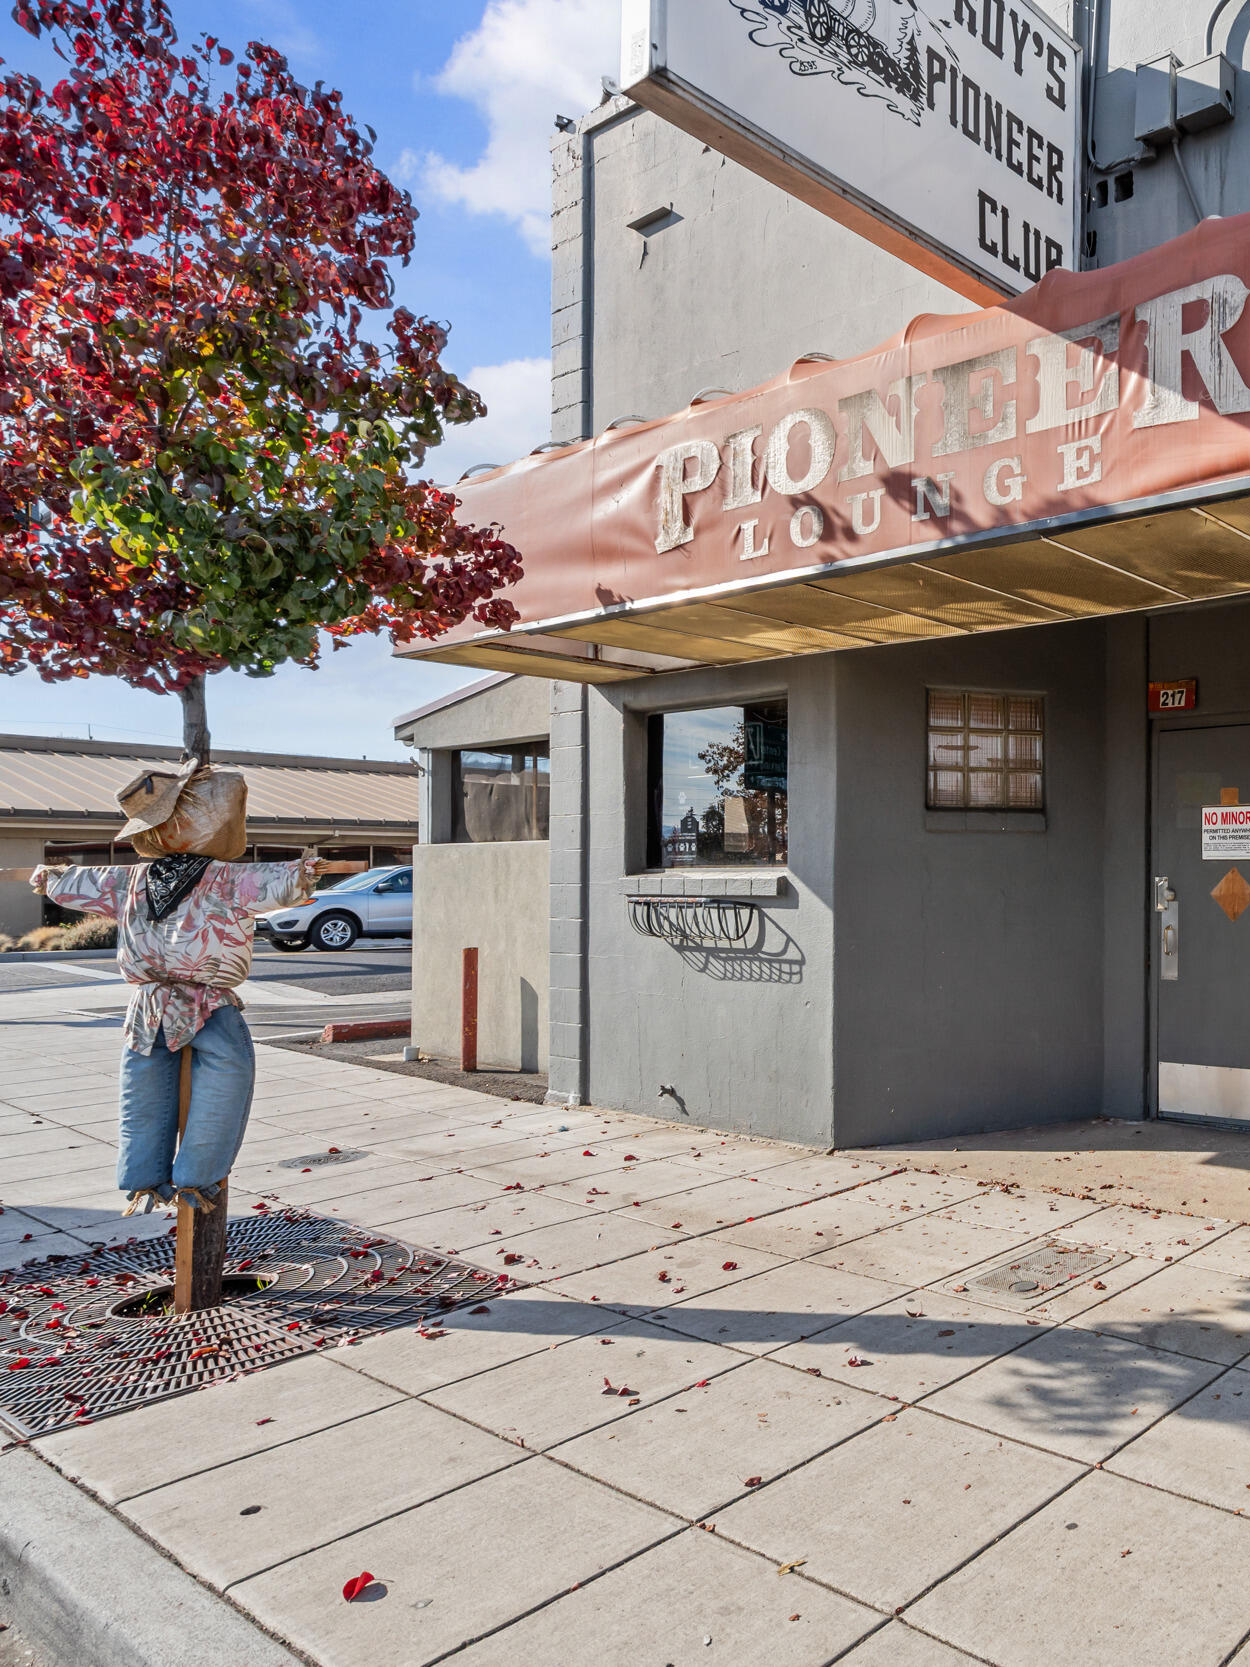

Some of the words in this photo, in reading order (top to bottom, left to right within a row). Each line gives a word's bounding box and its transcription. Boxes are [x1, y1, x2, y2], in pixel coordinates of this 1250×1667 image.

[926, 44, 1065, 206] PIONEER
[738, 433, 1102, 562] LOUNGE
[1161, 690, 1185, 707] 217
[1204, 811, 1218, 826] NO
